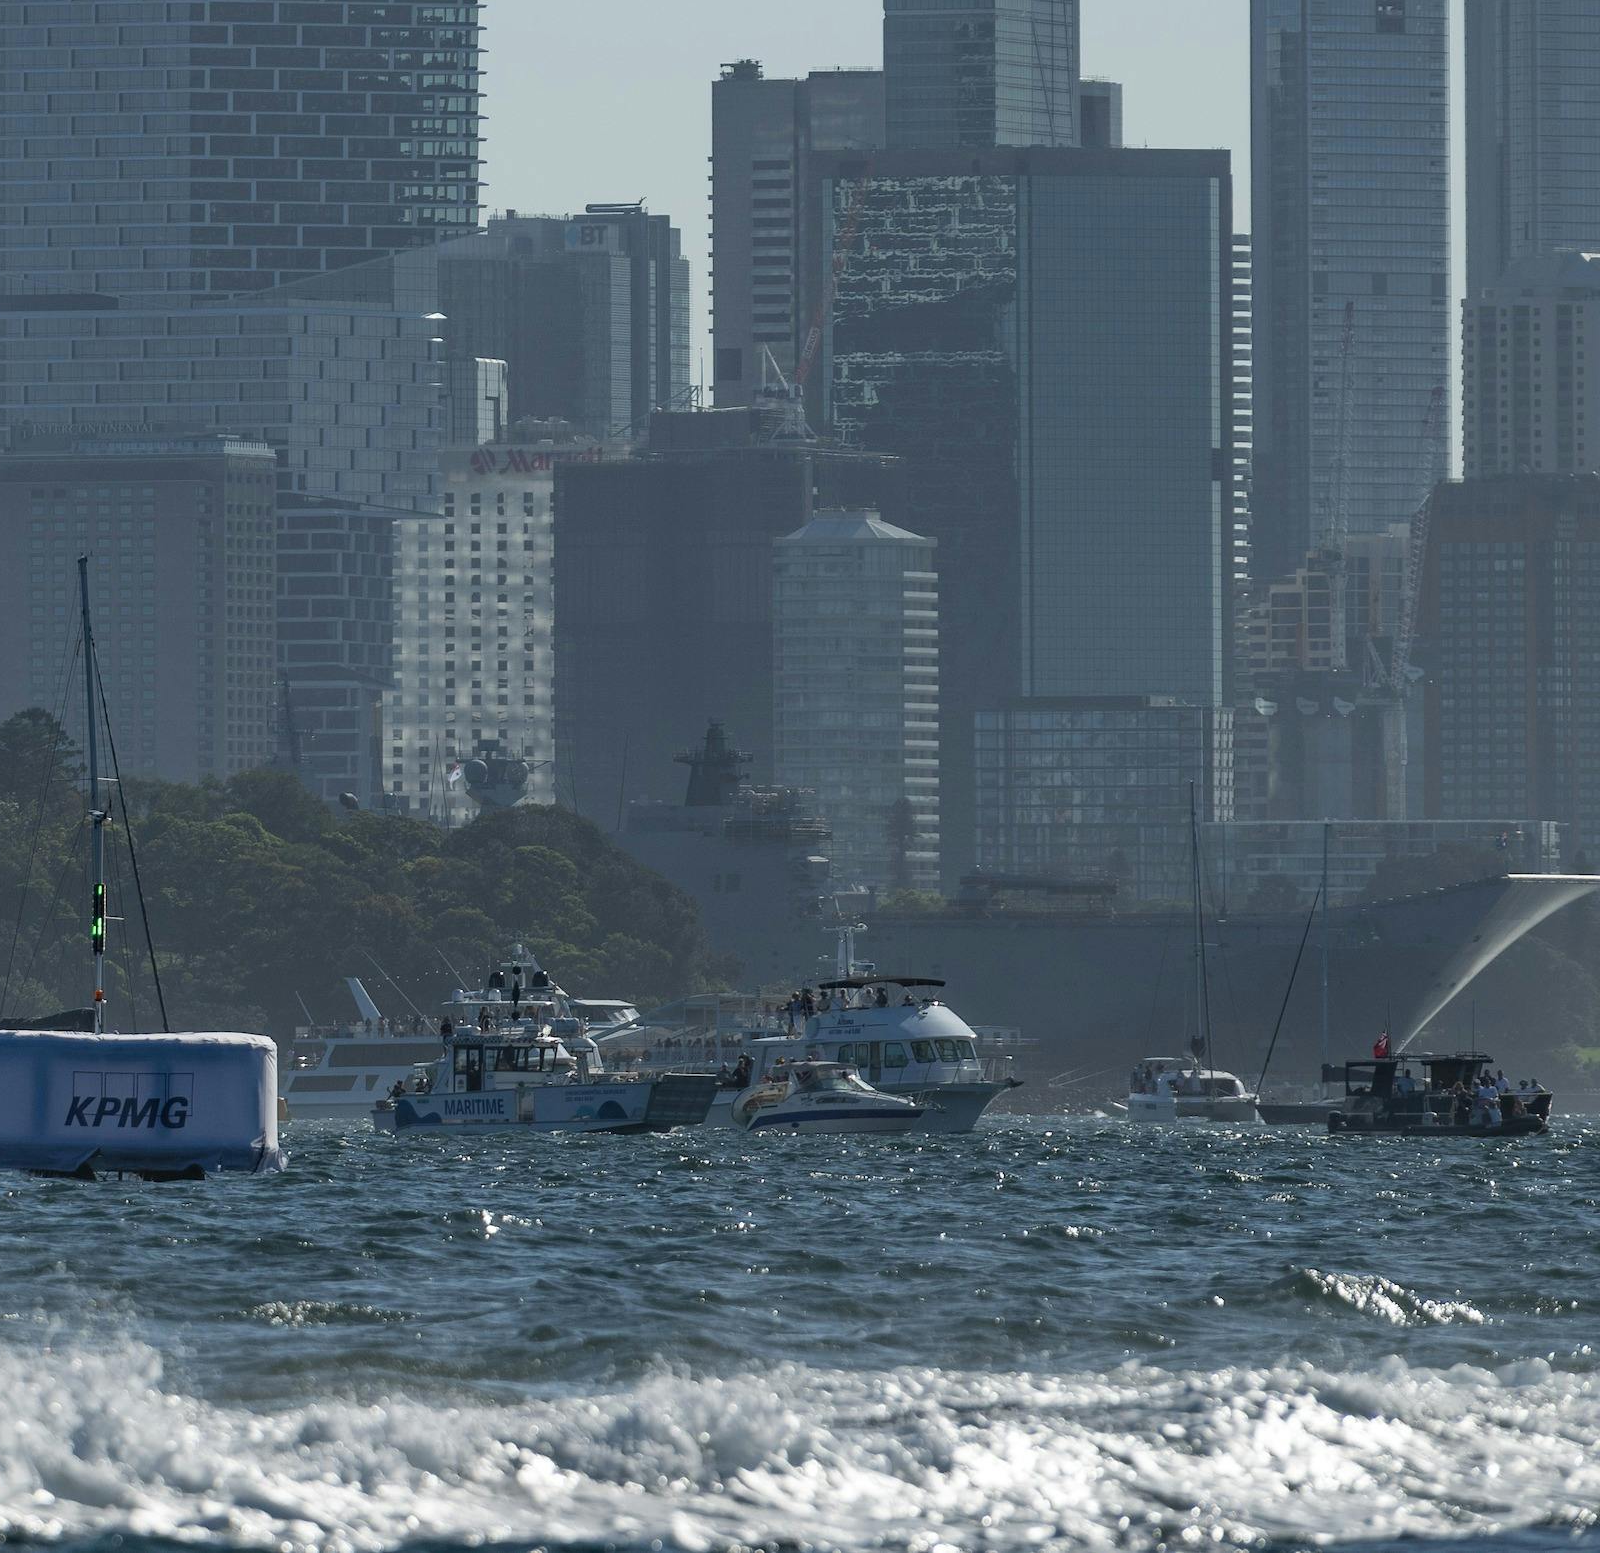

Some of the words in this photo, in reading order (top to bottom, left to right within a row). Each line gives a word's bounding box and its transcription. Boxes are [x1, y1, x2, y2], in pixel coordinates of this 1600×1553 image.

[580, 225, 608, 245] BT
[64, 1095, 189, 1129] KPMG
[444, 1098, 505, 1116] MARITIME
